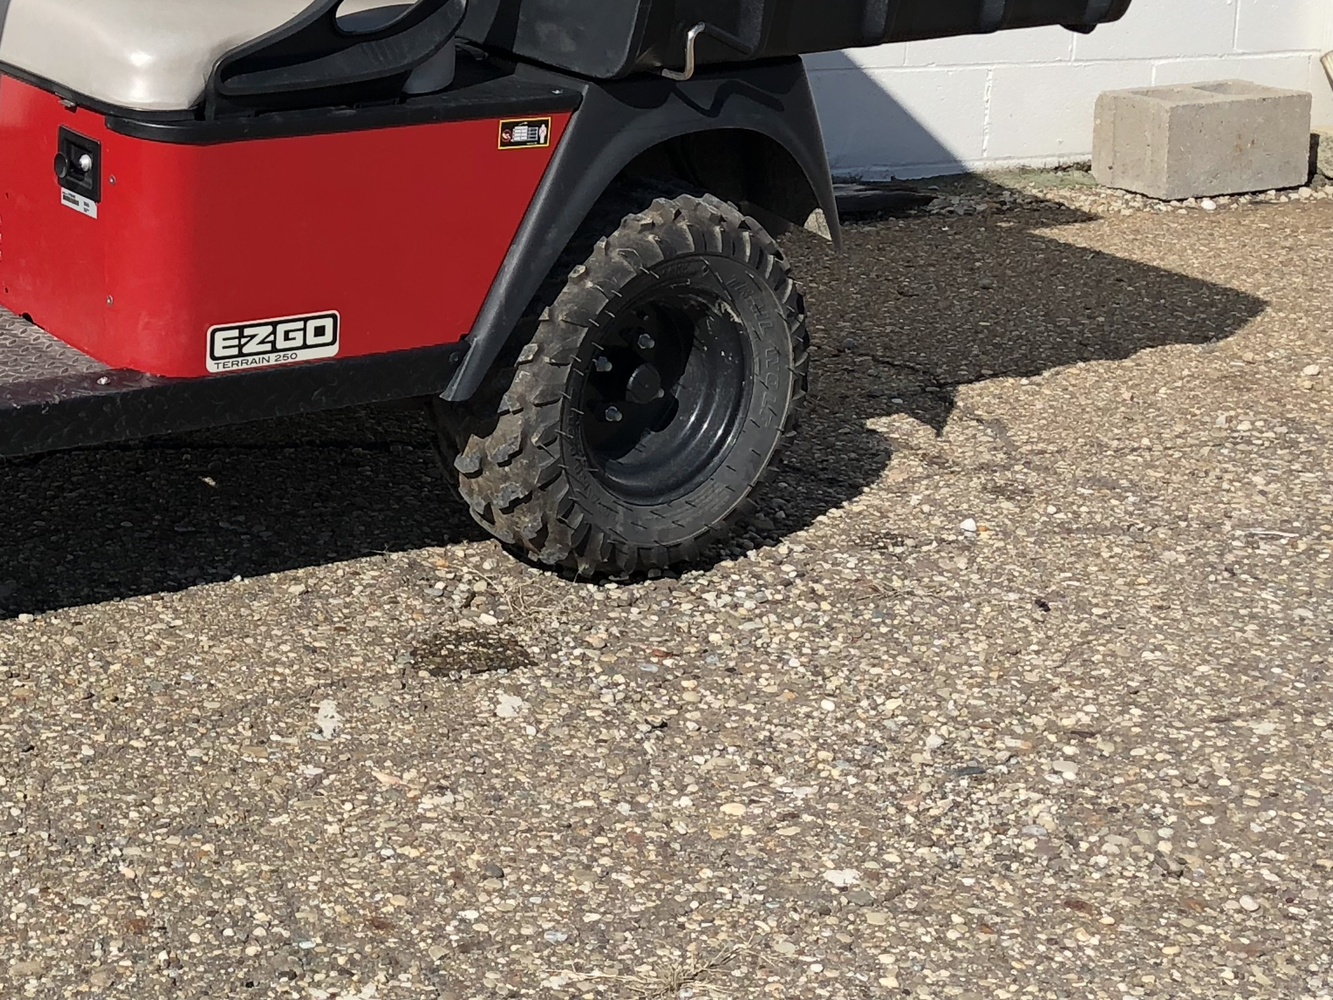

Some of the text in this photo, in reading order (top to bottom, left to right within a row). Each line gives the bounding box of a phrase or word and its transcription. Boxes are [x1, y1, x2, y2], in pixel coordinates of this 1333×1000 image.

[214, 317, 334, 357] EZGO
[215, 353, 298, 370] TERRAIN 250
